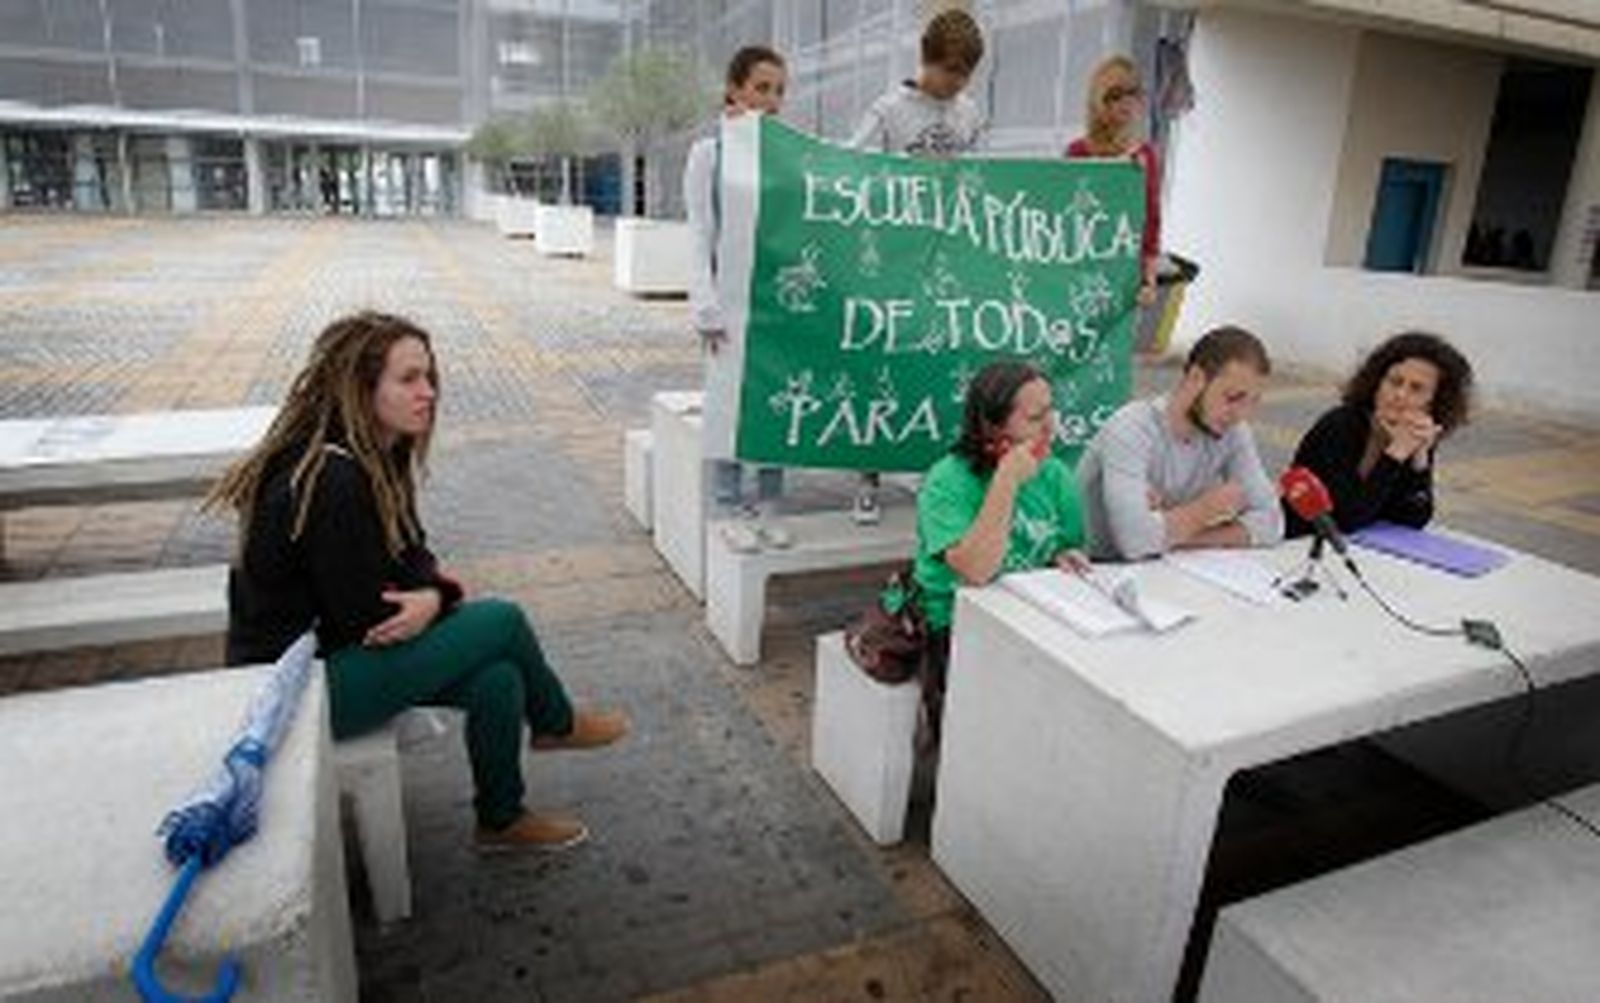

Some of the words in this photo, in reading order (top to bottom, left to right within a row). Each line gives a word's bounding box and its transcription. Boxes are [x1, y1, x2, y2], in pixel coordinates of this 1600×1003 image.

[802, 172, 981, 248] ESCUELA
[839, 297, 917, 353] DE
[785, 394, 942, 447] PARA
